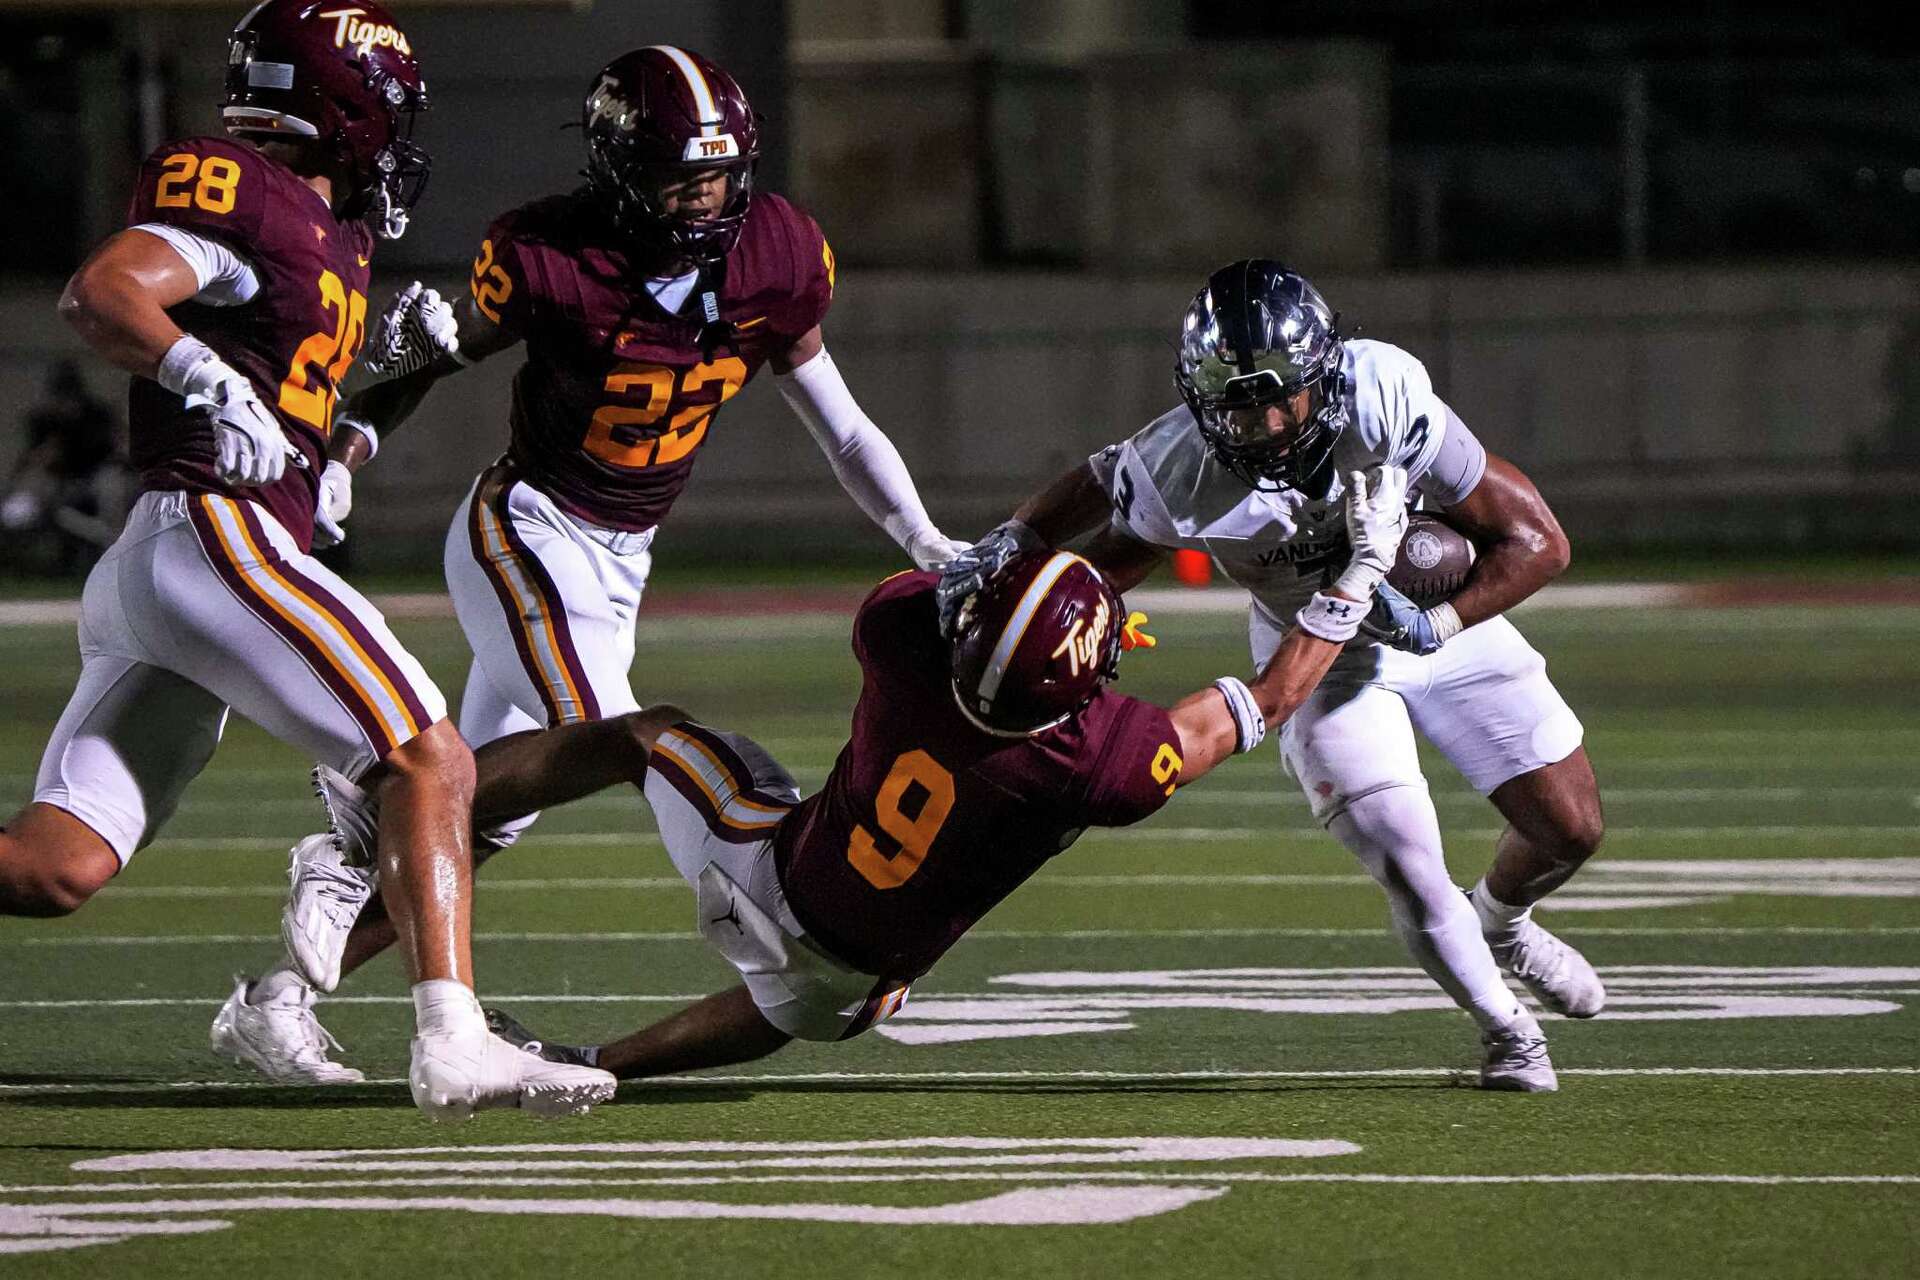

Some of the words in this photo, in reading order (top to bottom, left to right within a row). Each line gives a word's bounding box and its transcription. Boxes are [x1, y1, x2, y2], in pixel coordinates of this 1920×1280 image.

[319, 8, 411, 59] Tigers
[699, 140, 728, 156] TPD
[155, 153, 241, 215] 28
[582, 356, 747, 467] 22
[1051, 591, 1110, 677] Tigers
[1151, 743, 1183, 797] 9
[847, 749, 956, 890] 9
